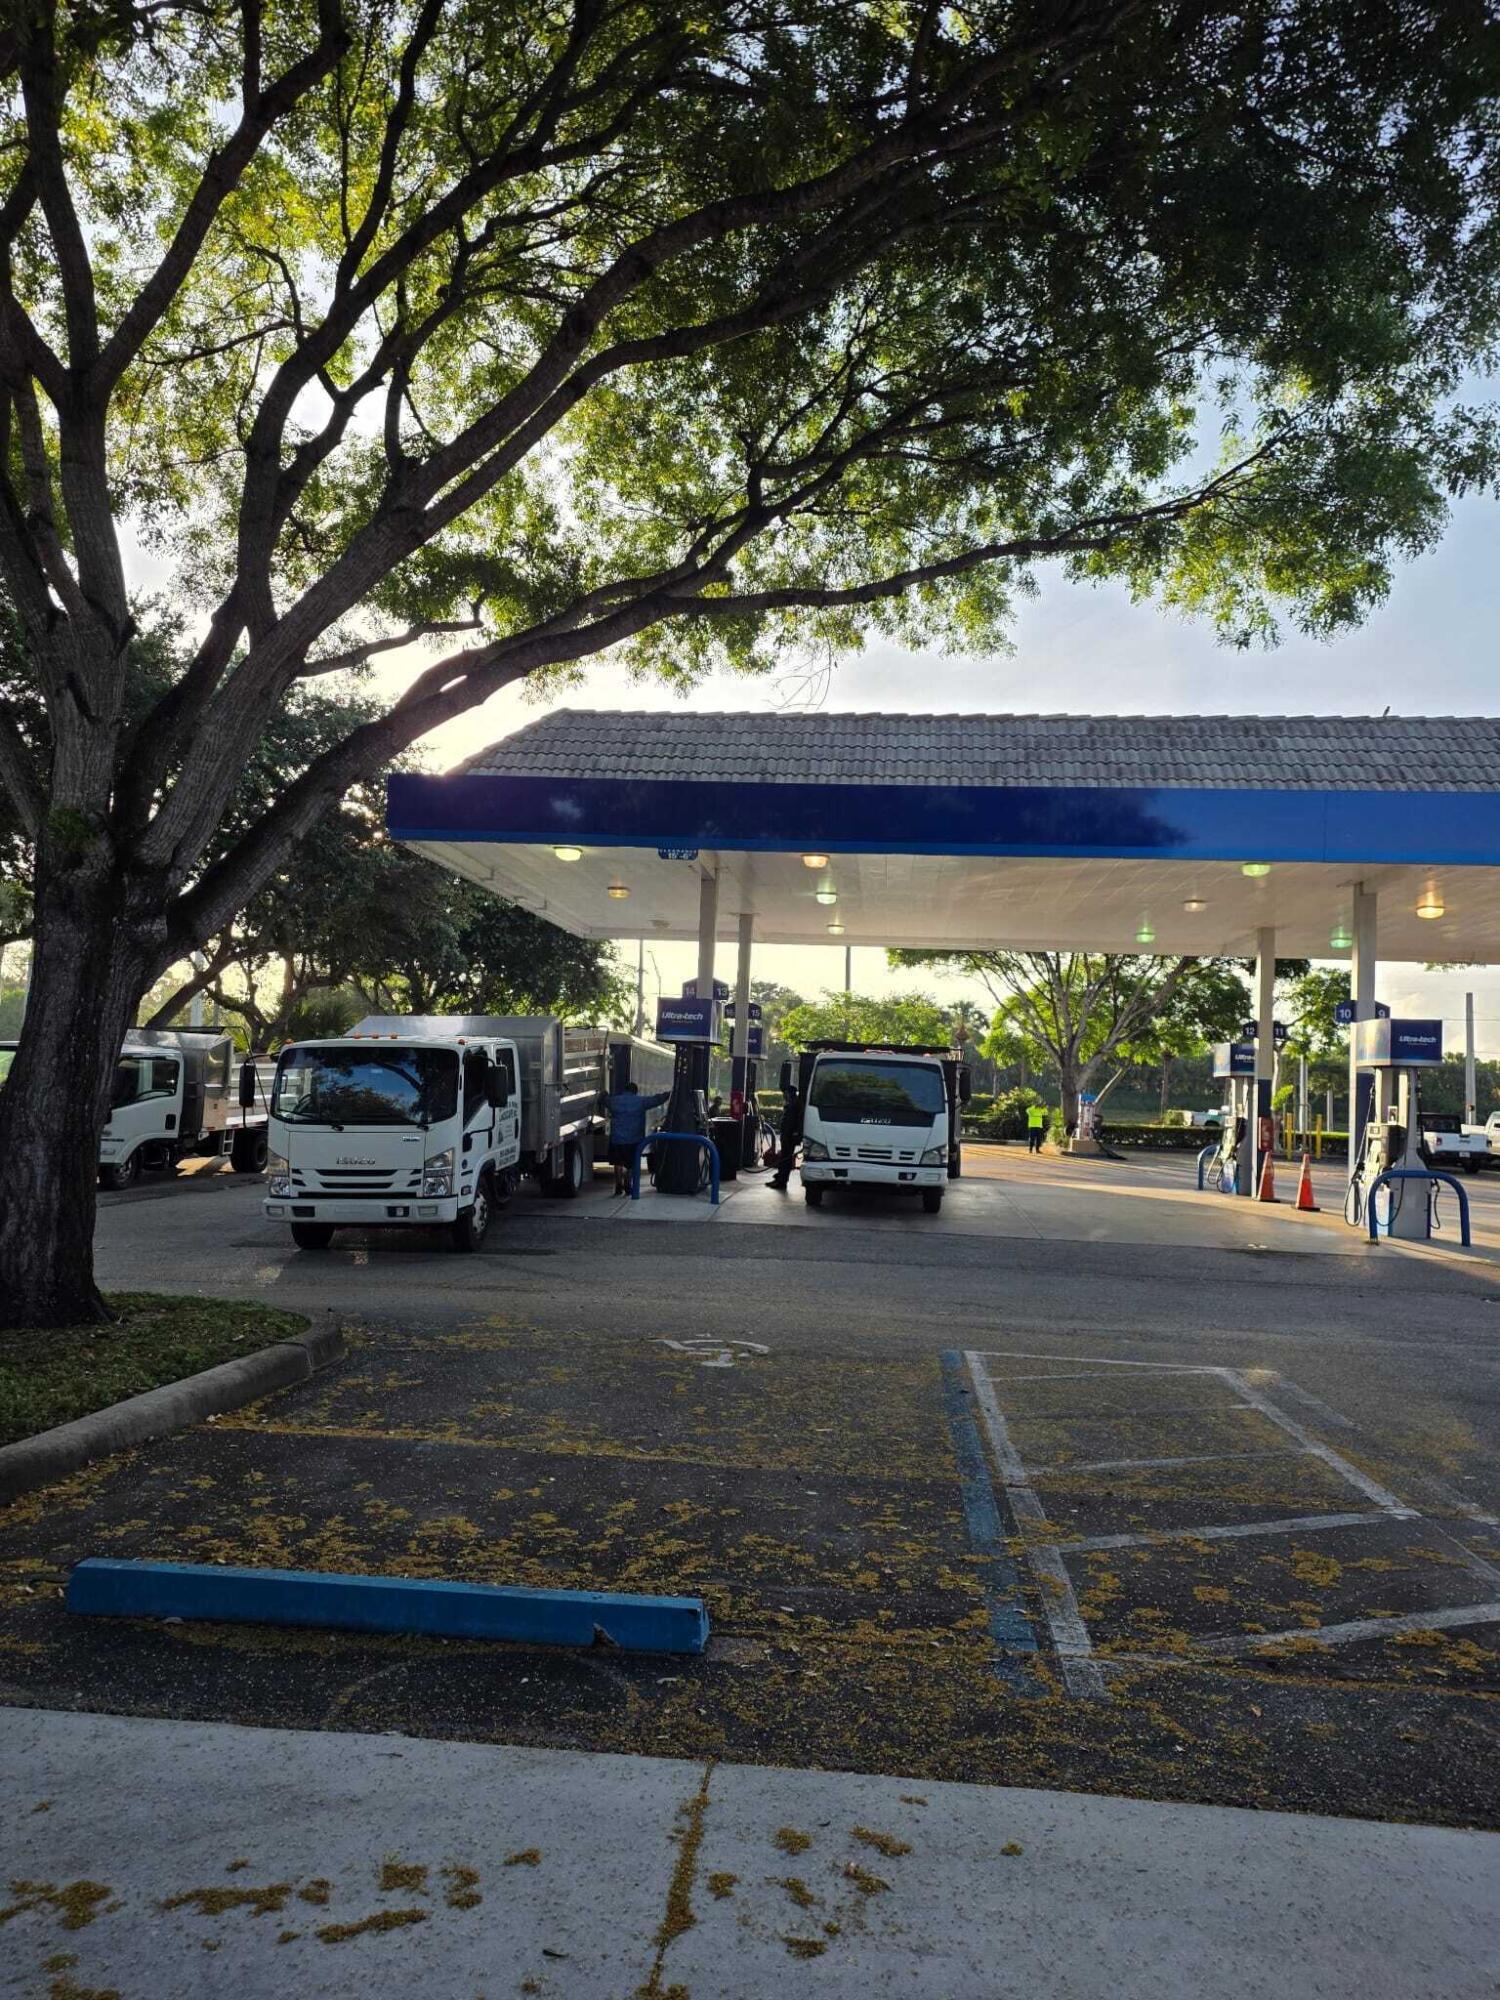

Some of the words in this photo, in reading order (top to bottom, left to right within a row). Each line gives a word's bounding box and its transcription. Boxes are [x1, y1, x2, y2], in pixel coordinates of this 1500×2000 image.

[685, 986, 695, 996] 14
[717, 987, 728, 997] 13
[661, 1011, 704, 1021] Ultra-tech
[751, 1009, 760, 1017] 15
[1339, 1009, 1352, 1019] 10
[1378, 1009, 1386, 1019] 9
[1244, 1027, 1255, 1036] 12
[1275, 1028, 1284, 1036] 11
[336, 1156, 376, 1165] ISUZU
